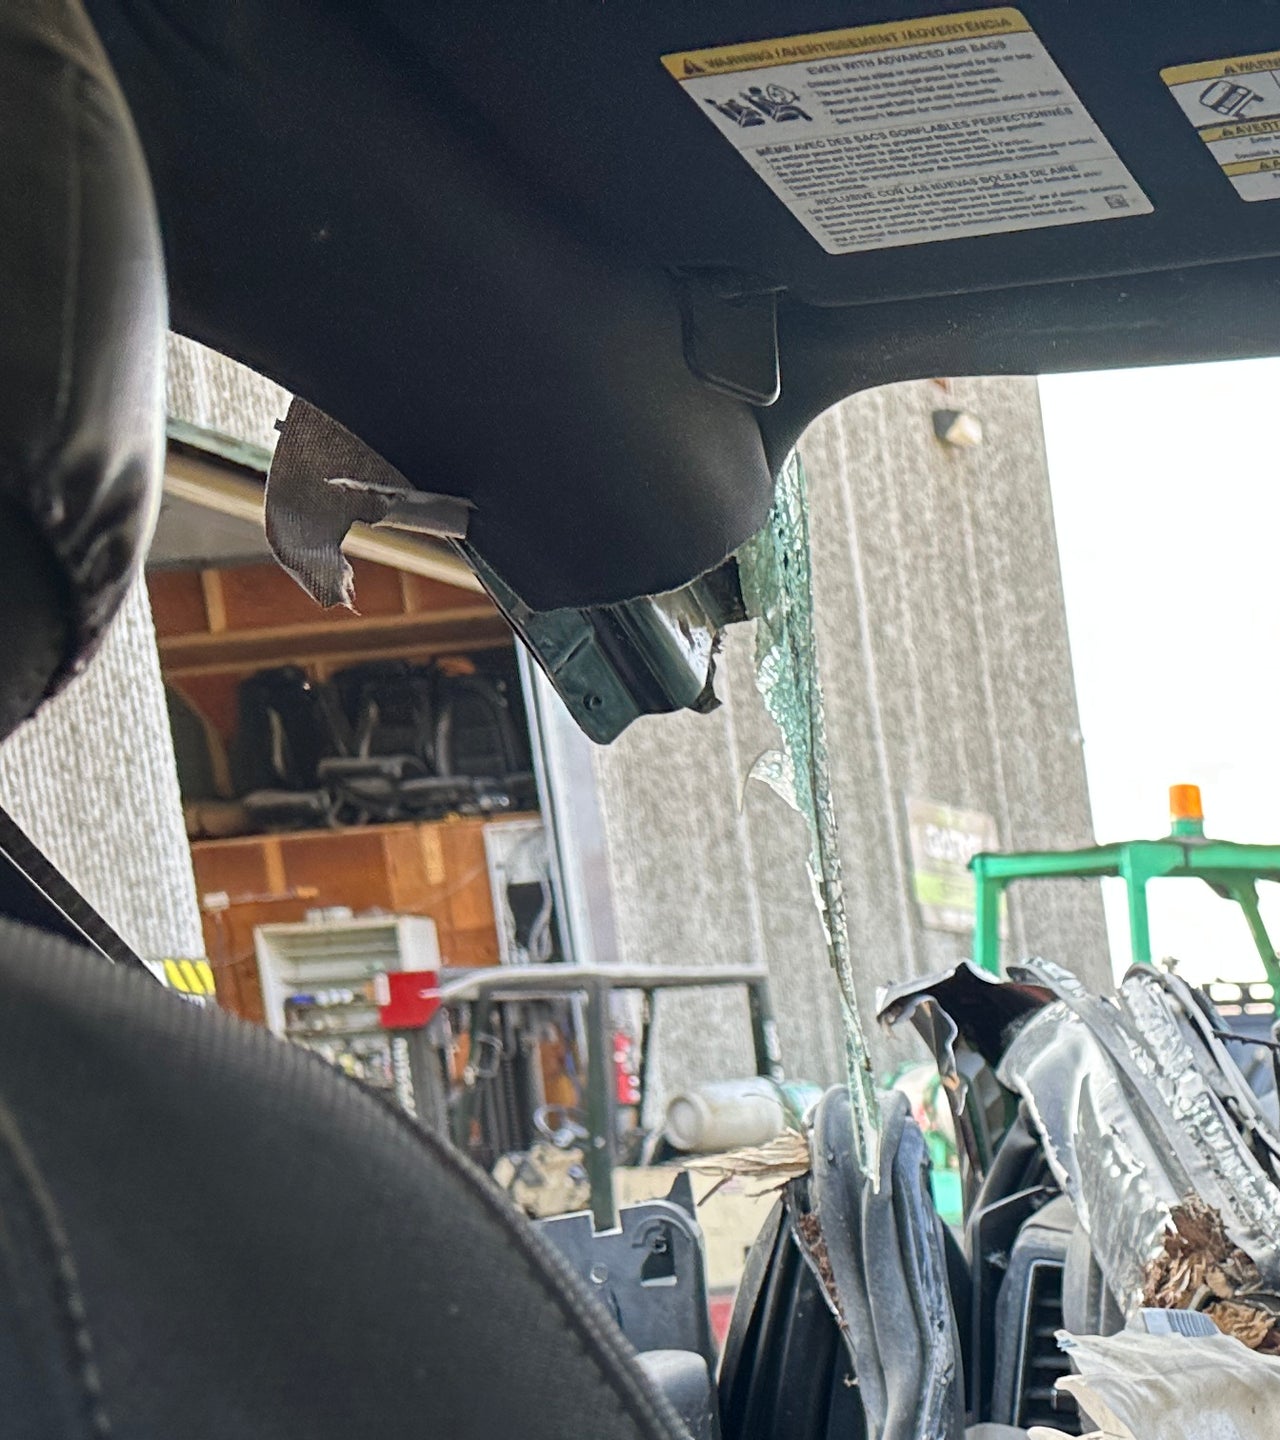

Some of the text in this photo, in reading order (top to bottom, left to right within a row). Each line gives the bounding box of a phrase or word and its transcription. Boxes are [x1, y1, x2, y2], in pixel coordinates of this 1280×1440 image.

[702, 49, 775, 68] WARNING
[804, 40, 1008, 75] EVEN WITH ADVANCED AIR BAGS
